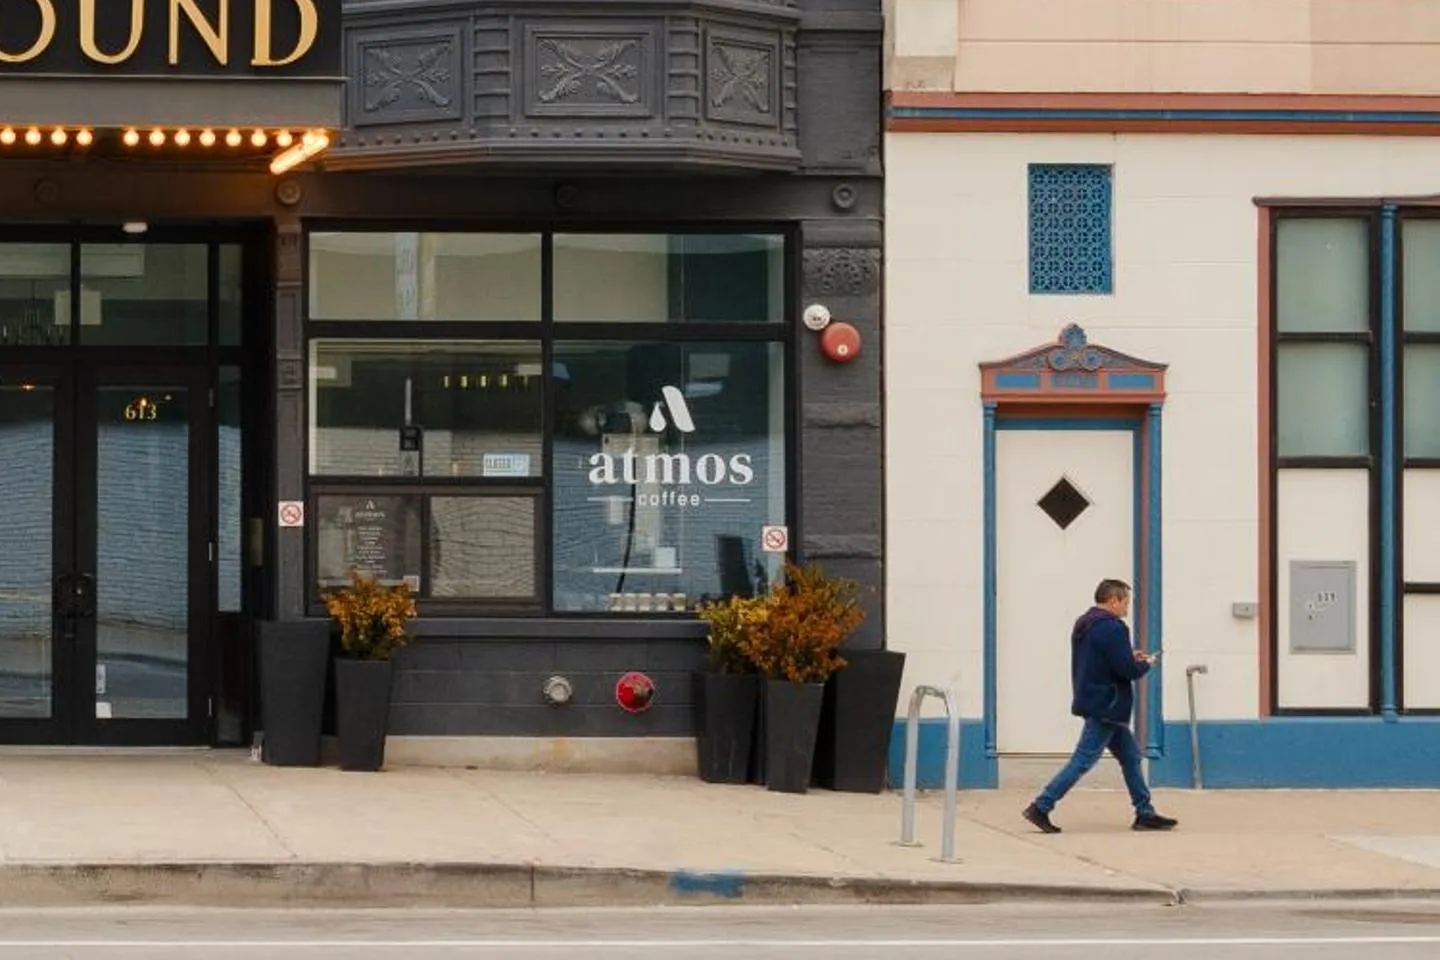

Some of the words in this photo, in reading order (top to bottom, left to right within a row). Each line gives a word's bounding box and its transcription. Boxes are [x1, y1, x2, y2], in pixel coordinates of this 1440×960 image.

[125, 404, 157, 420] 613
[588, 446, 754, 485] atmos
[638, 491, 701, 506] coffee
